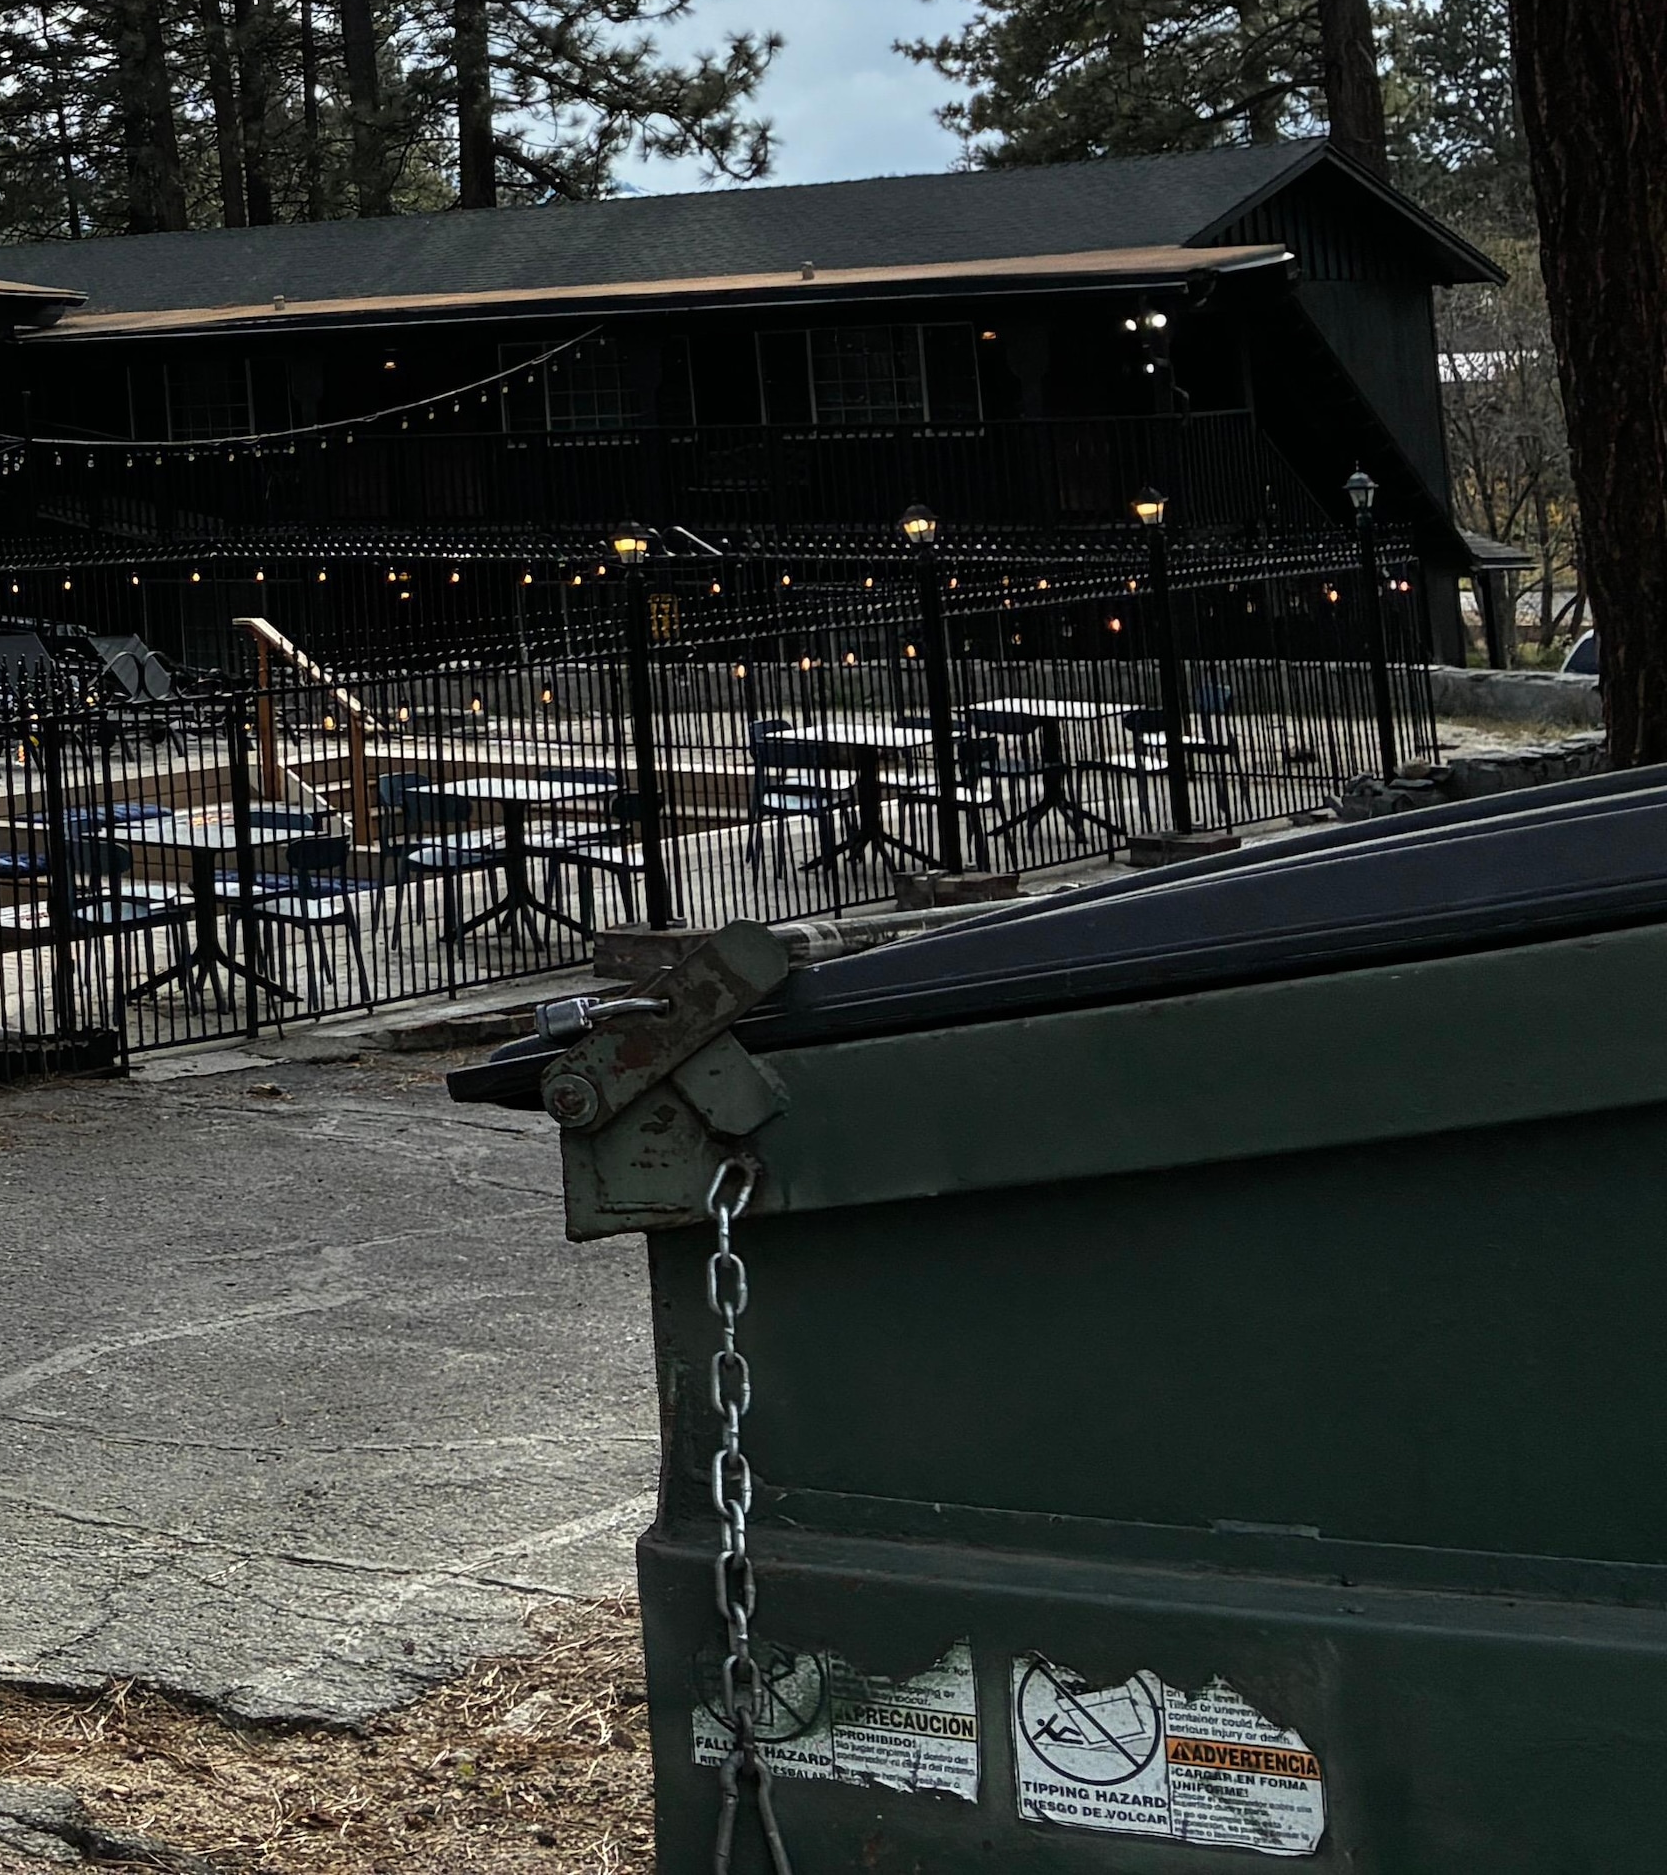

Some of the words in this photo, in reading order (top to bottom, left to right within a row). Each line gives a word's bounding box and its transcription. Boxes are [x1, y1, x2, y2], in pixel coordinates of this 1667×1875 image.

[764, 1746, 832, 1767] HAZARD
[1193, 1743, 1318, 1775] ADVERTENCIA
[1022, 1780, 1090, 1800] TIPPING
[1095, 1790, 1168, 1809] HAZARD
[1236, 1773, 1256, 1785] EN
[1260, 1776, 1309, 1791] FORMA
[1023, 1798, 1078, 1815] RIESGO
[1082, 1806, 1102, 1818] DE
[1107, 1809, 1168, 1825] VOLCAR
